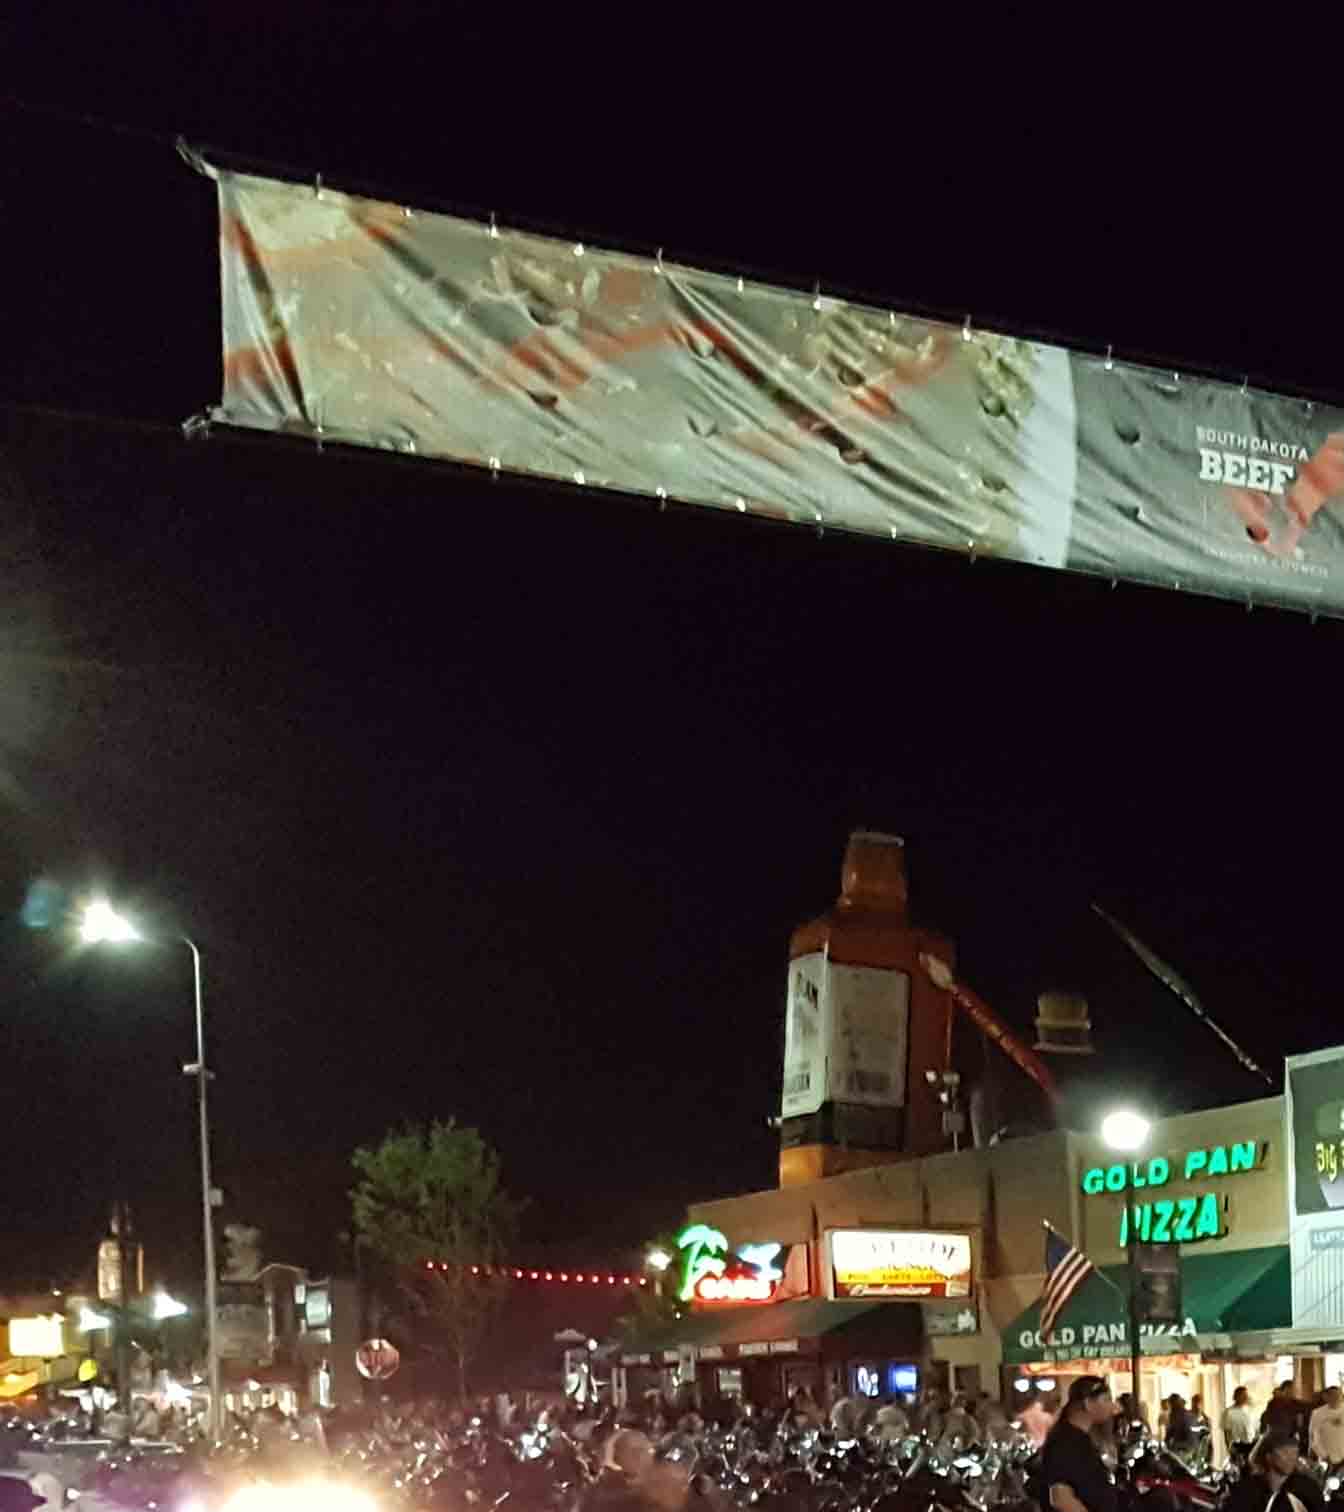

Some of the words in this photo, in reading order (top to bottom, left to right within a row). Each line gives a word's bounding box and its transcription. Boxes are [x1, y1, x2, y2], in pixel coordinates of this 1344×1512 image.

[1199, 447, 1294, 496] BEEF
[1250, 436, 1310, 463] DAKOTA
[1081, 1160, 1170, 1195] GOLD
[1184, 1140, 1258, 1180] PAN
[1119, 1192, 1220, 1248] PIZZA
[1082, 1322, 1126, 1343] PAN
